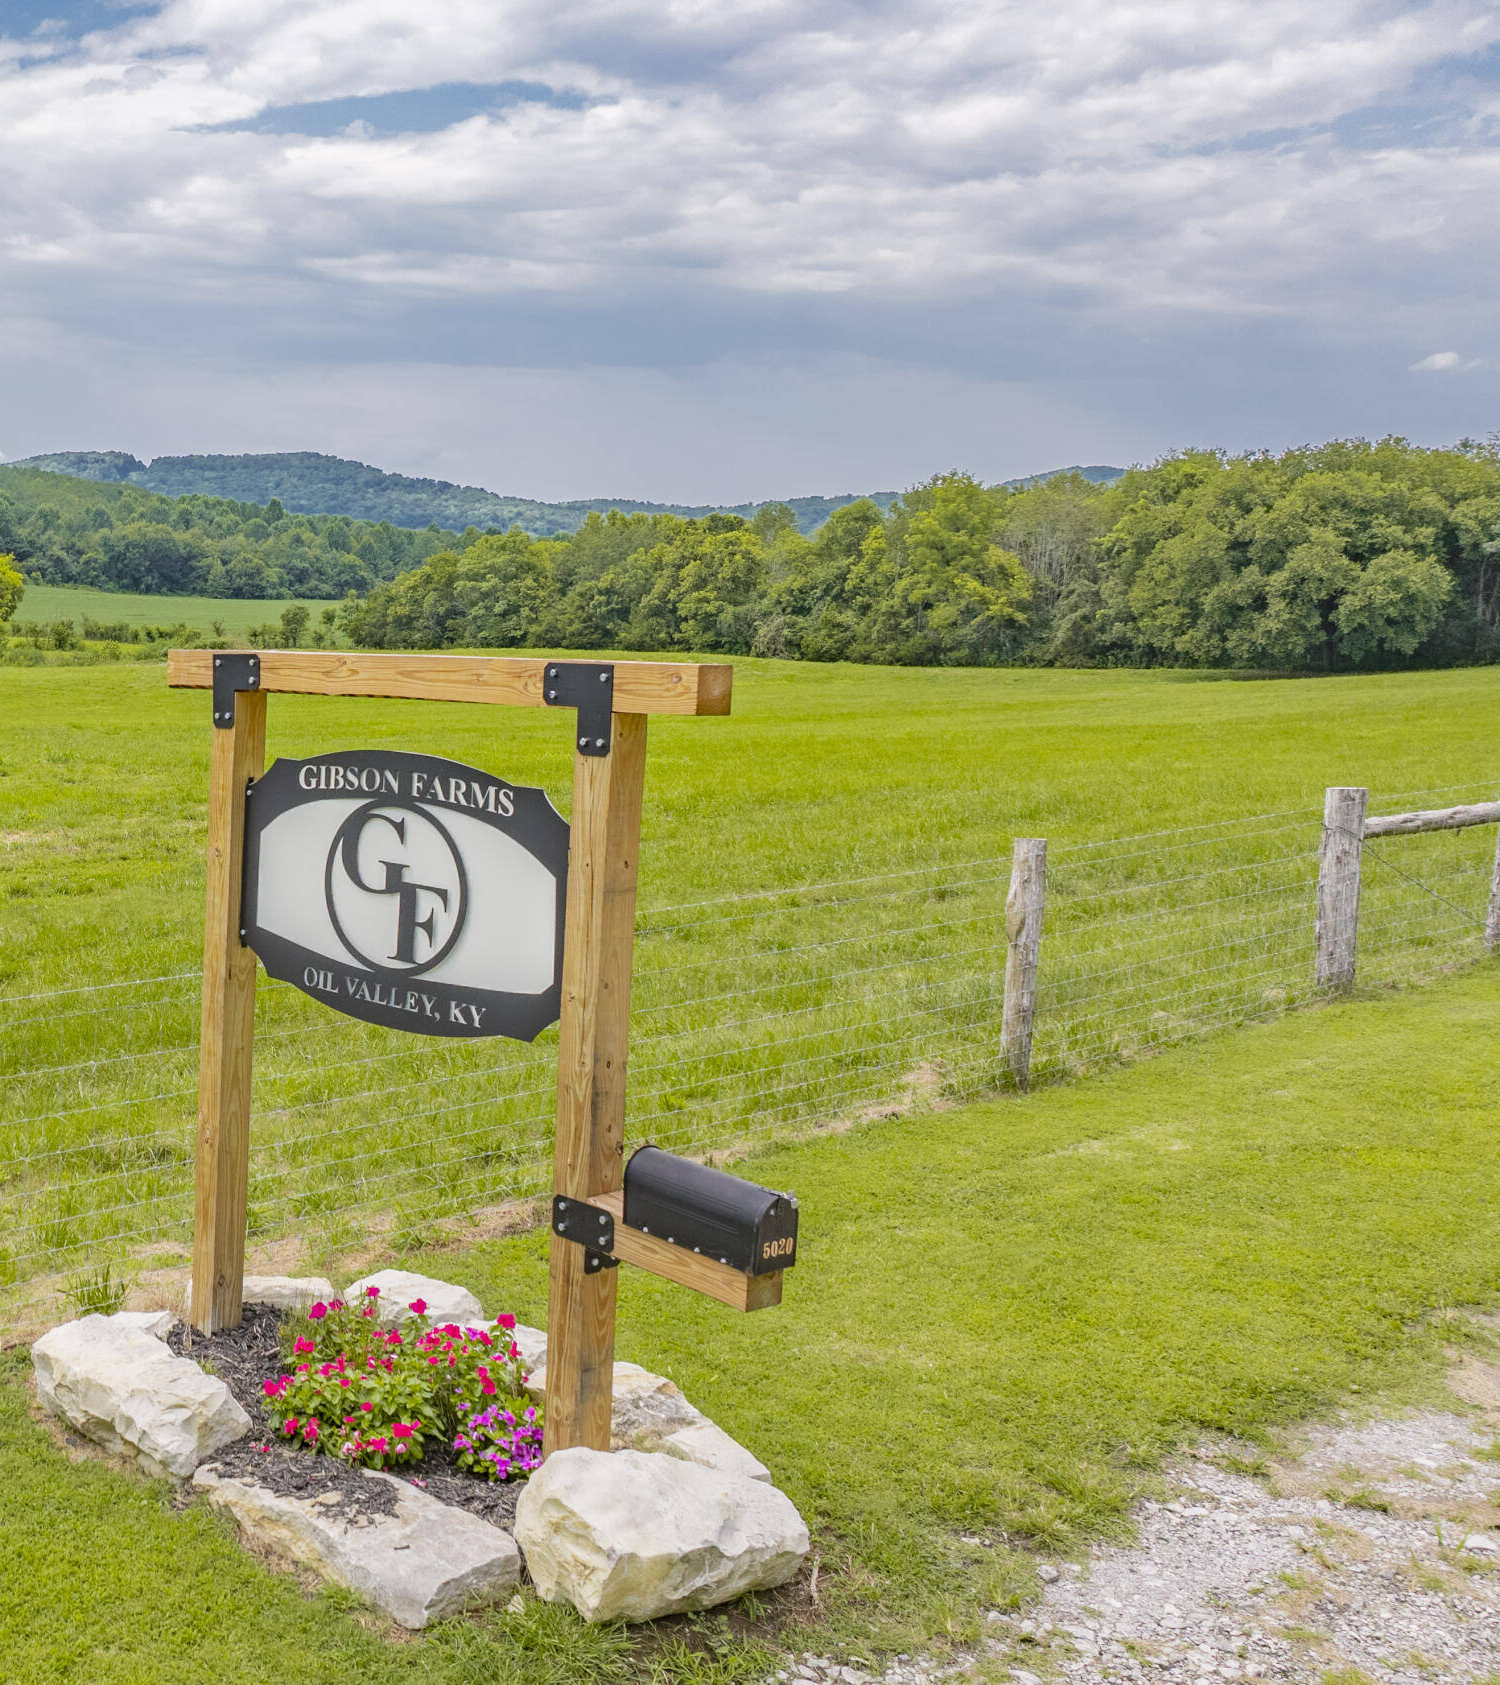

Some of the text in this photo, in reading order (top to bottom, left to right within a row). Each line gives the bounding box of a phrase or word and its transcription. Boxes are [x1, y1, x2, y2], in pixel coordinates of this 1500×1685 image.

[299, 764, 515, 817] GIBSON FARMS
[303, 966, 487, 1028] OIL VALLEY, KY
[763, 1237, 794, 1259] 5020
